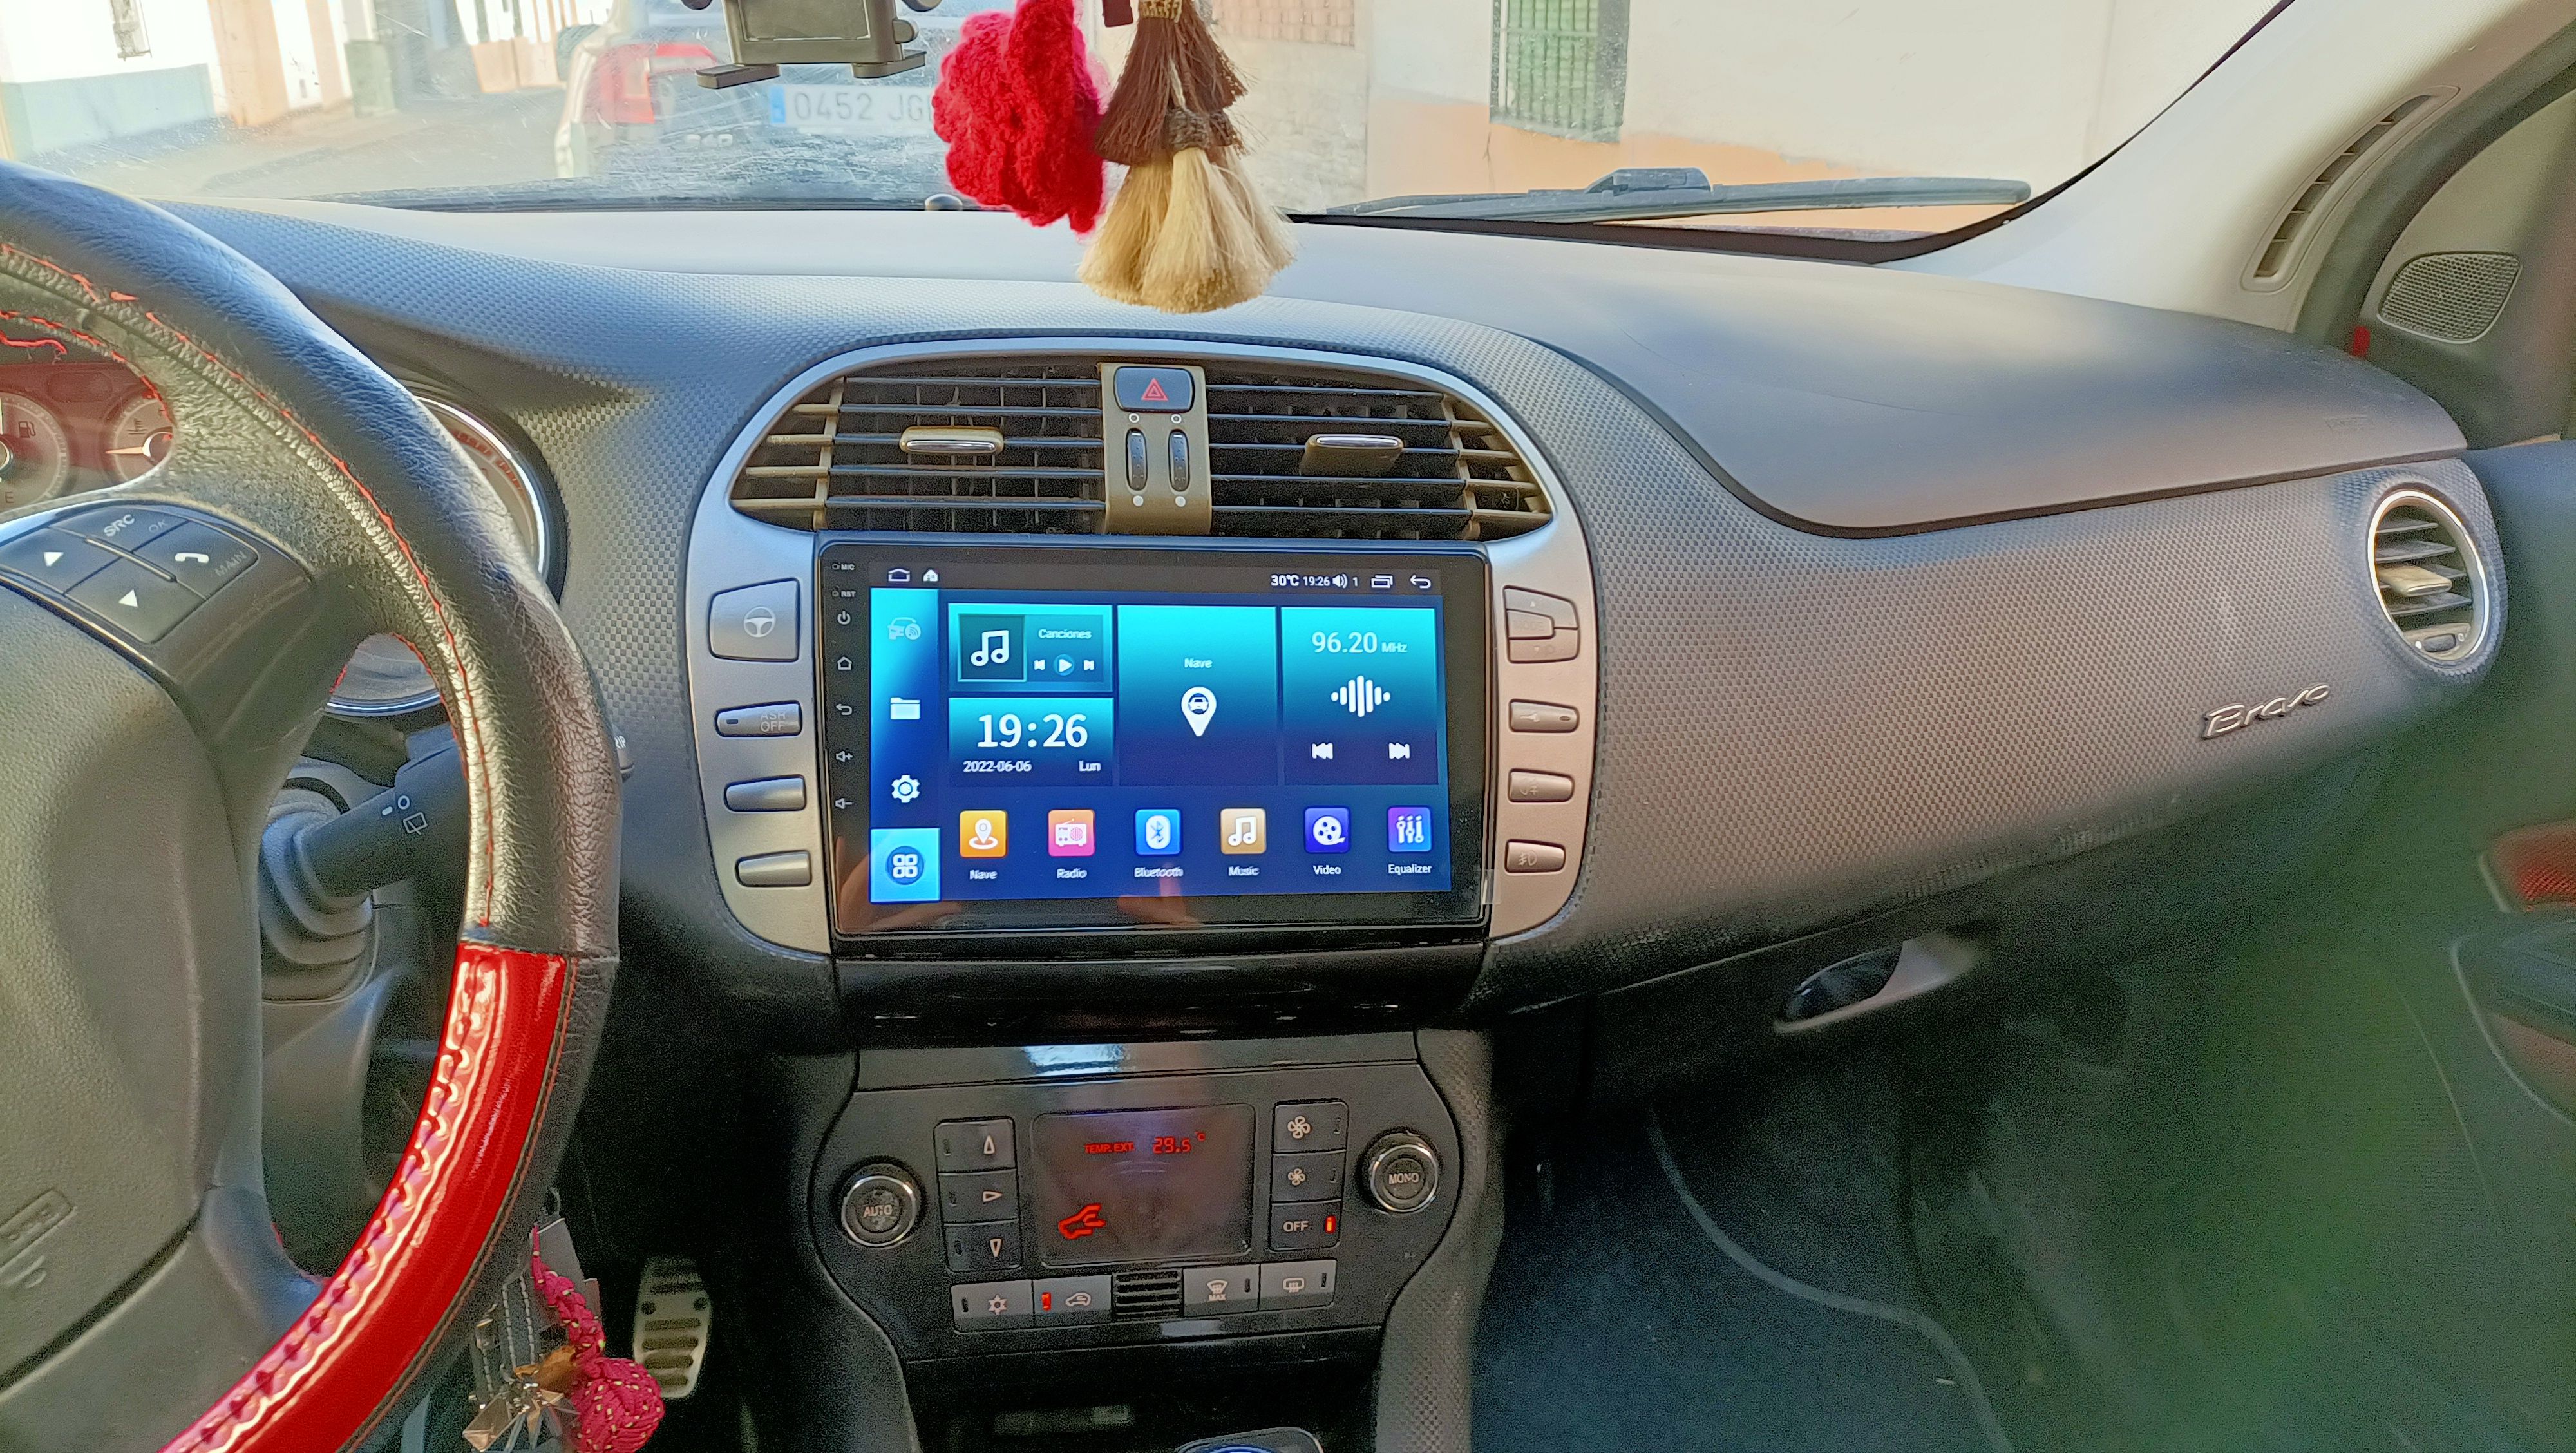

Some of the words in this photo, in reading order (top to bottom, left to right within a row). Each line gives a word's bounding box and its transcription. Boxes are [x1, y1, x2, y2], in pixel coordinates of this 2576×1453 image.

[794, 92, 873, 120] 0452
[888, 93, 932, 121] JG
[104, 514, 135, 537] SRC
[149, 519, 170, 532] OK
[1303, 576, 1330, 586] 19:26
[1353, 577, 1358, 586] 1
[1039, 629, 1092, 639] Canciones
[1312, 631, 1377, 653] 96.20
[1381, 643, 1408, 653] MHz
[1184, 658, 1213, 669] Nave
[2205, 683, 2331, 737] Bravo
[760, 721, 786, 732] OFF
[978, 714, 1088, 748] 19:26
[963, 761, 1032, 772] 2022-06-06
[1079, 760, 1101, 772] Lun
[969, 869, 998, 880] Nave
[1057, 868, 1087, 878] Radio
[1134, 866, 1184, 878] Bluetooth
[1228, 866, 1260, 876] Music
[1313, 864, 1341, 875] Video
[1388, 863, 1432, 876] Equalizer
[1388, 1172, 1419, 1184] MONO
[862, 1205, 893, 1218] AUTO
[1283, 1221, 1309, 1231] OFF
